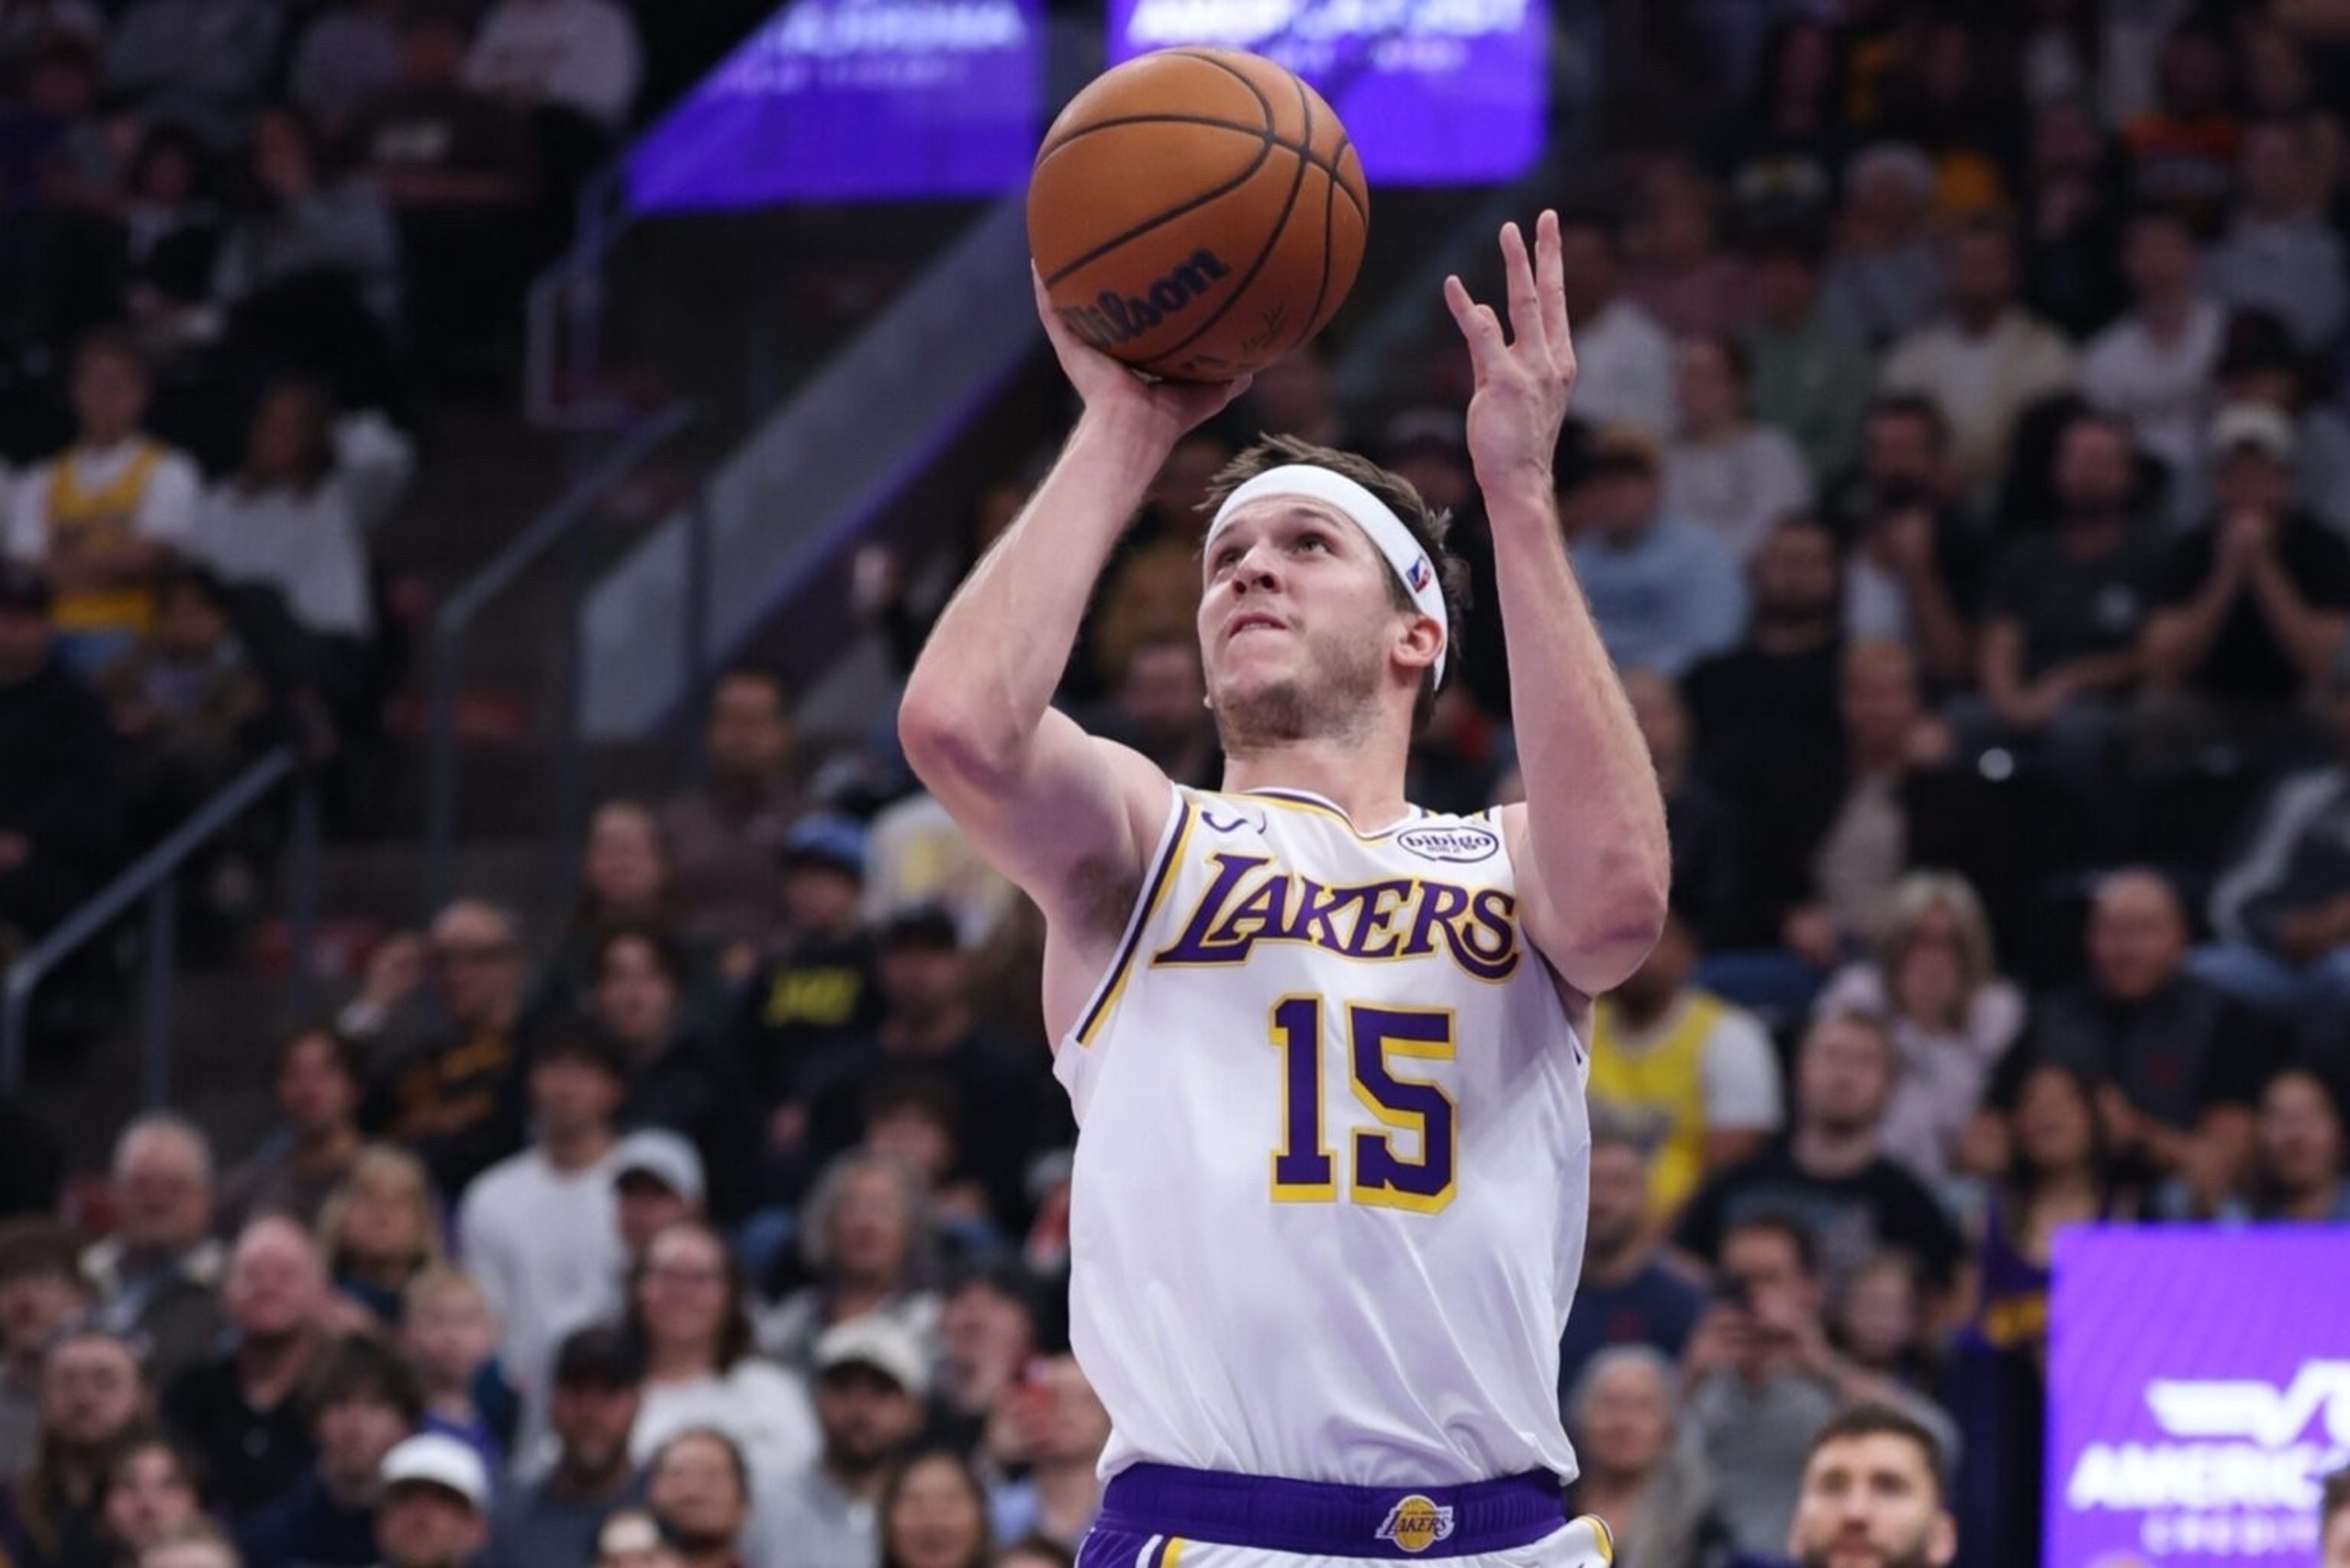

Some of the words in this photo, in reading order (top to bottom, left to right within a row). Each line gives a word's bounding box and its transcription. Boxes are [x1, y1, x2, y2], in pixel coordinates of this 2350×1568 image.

[1405, 834, 1491, 850] bibigo
[1151, 853, 1523, 984] LAKERS
[1269, 992, 1458, 1215] 15
[2069, 1442, 2322, 1511] AMERIC
[1382, 1510, 1449, 1538] LAKERS
